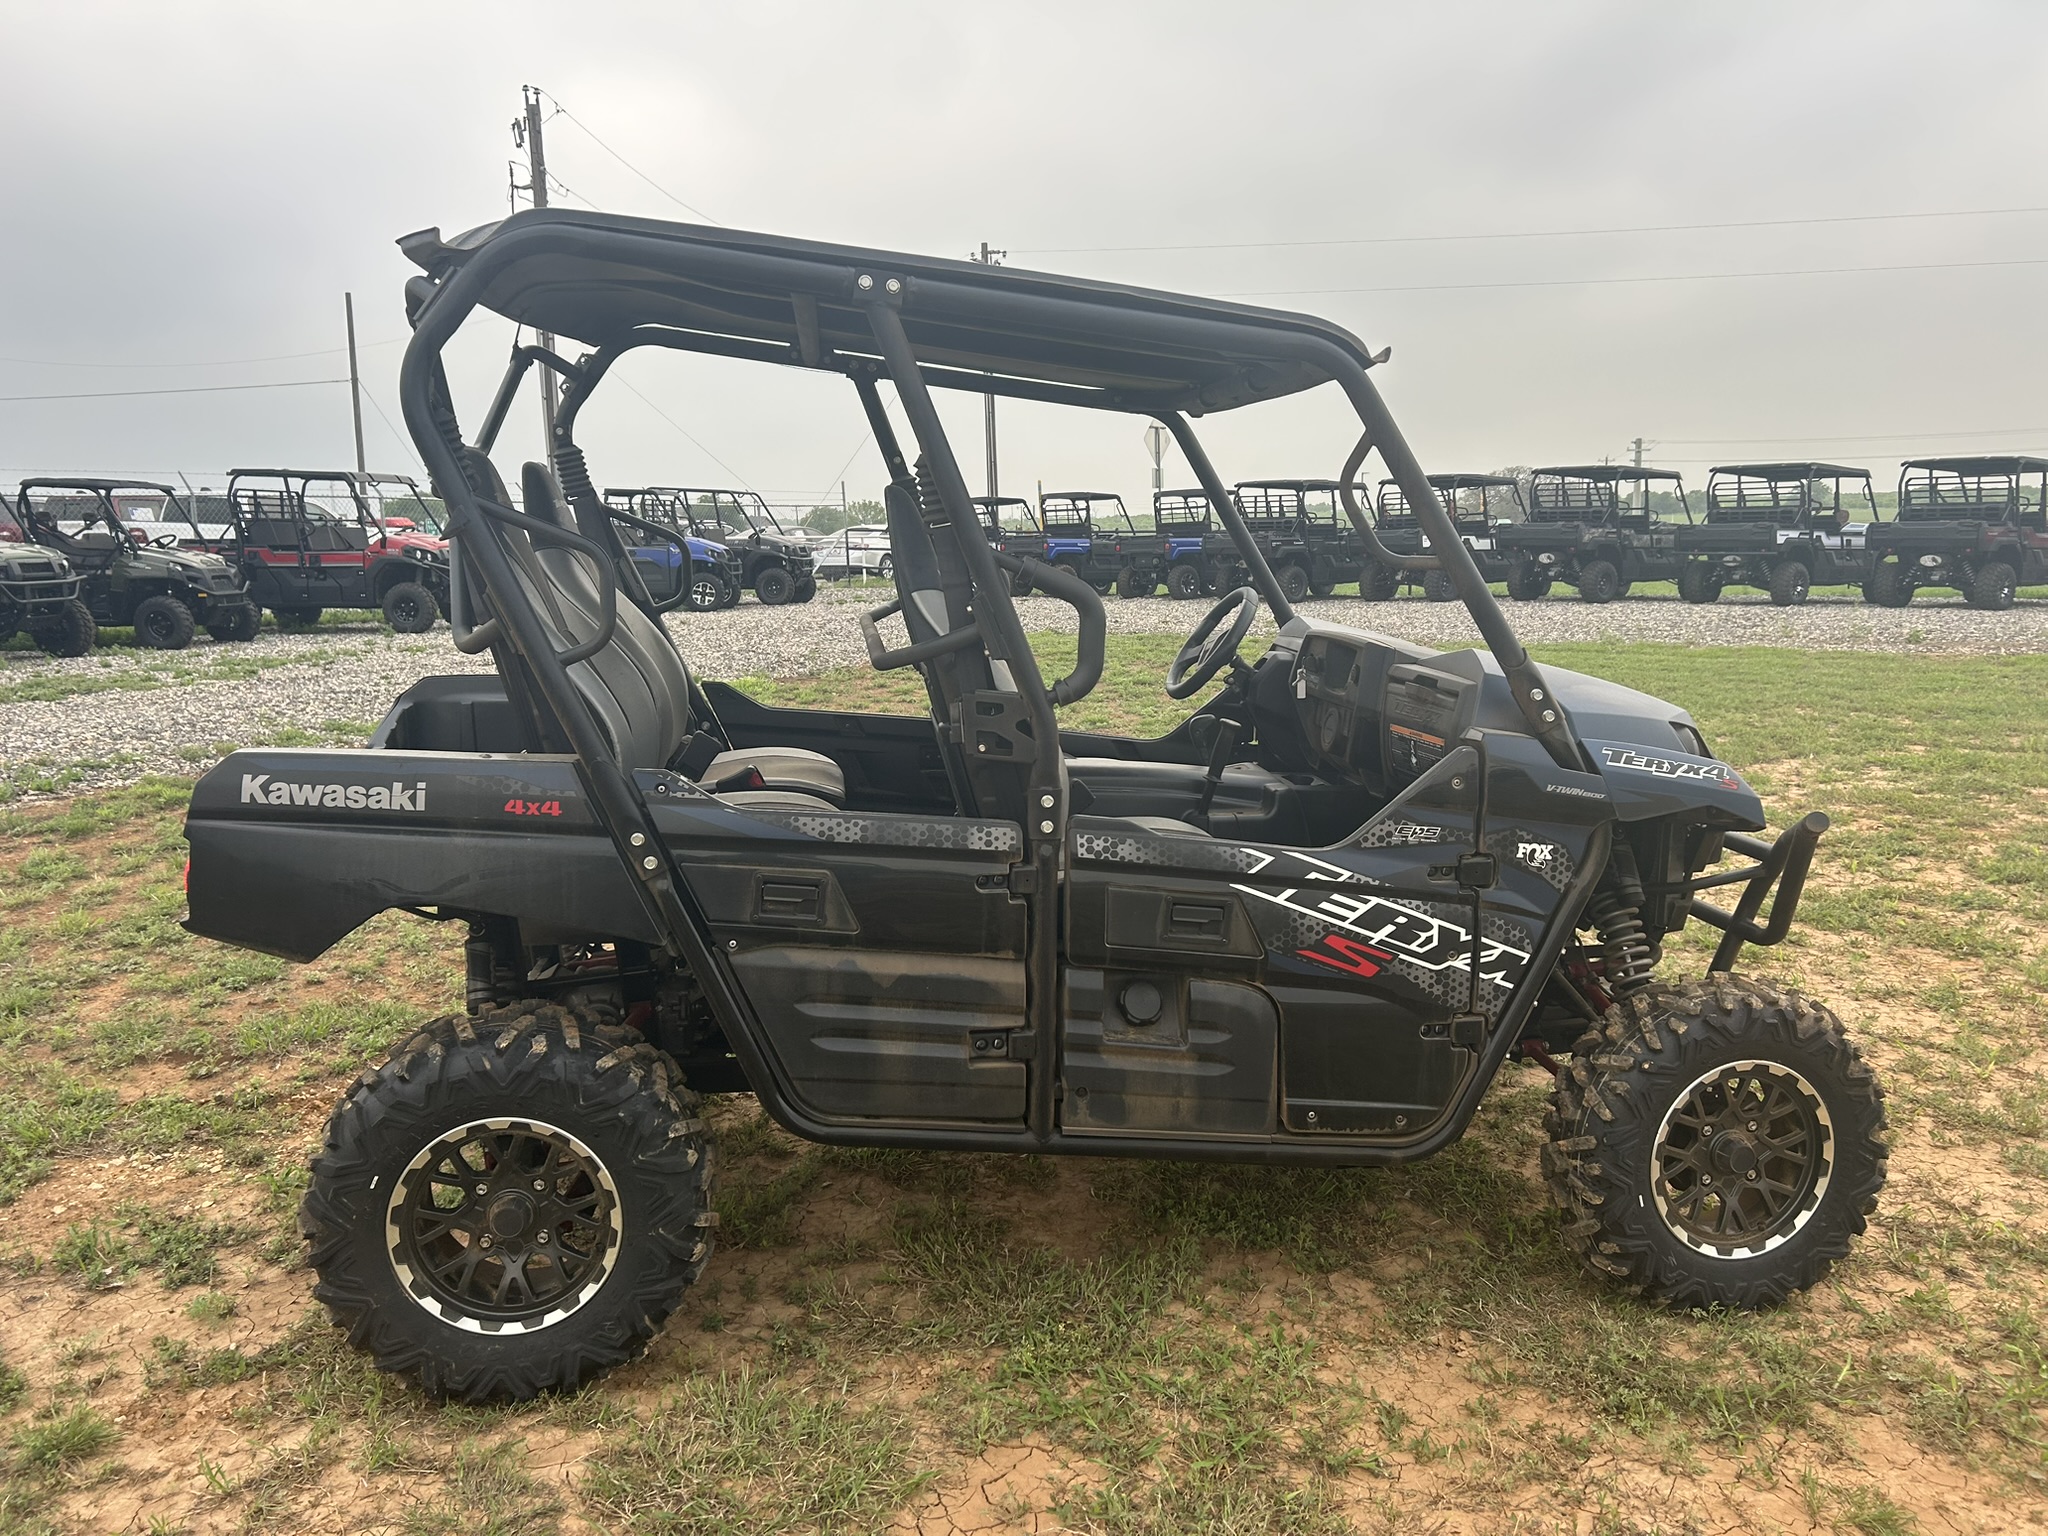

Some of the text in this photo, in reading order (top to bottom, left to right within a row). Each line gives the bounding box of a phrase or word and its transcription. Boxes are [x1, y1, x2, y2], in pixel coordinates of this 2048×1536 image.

[1601, 747, 1730, 781] TERYX4
[240, 773, 427, 812] Kawasaki
[504, 799, 563, 817] 4x4
[1395, 825, 1442, 840] EPS
[1515, 842, 1554, 869] FOX
